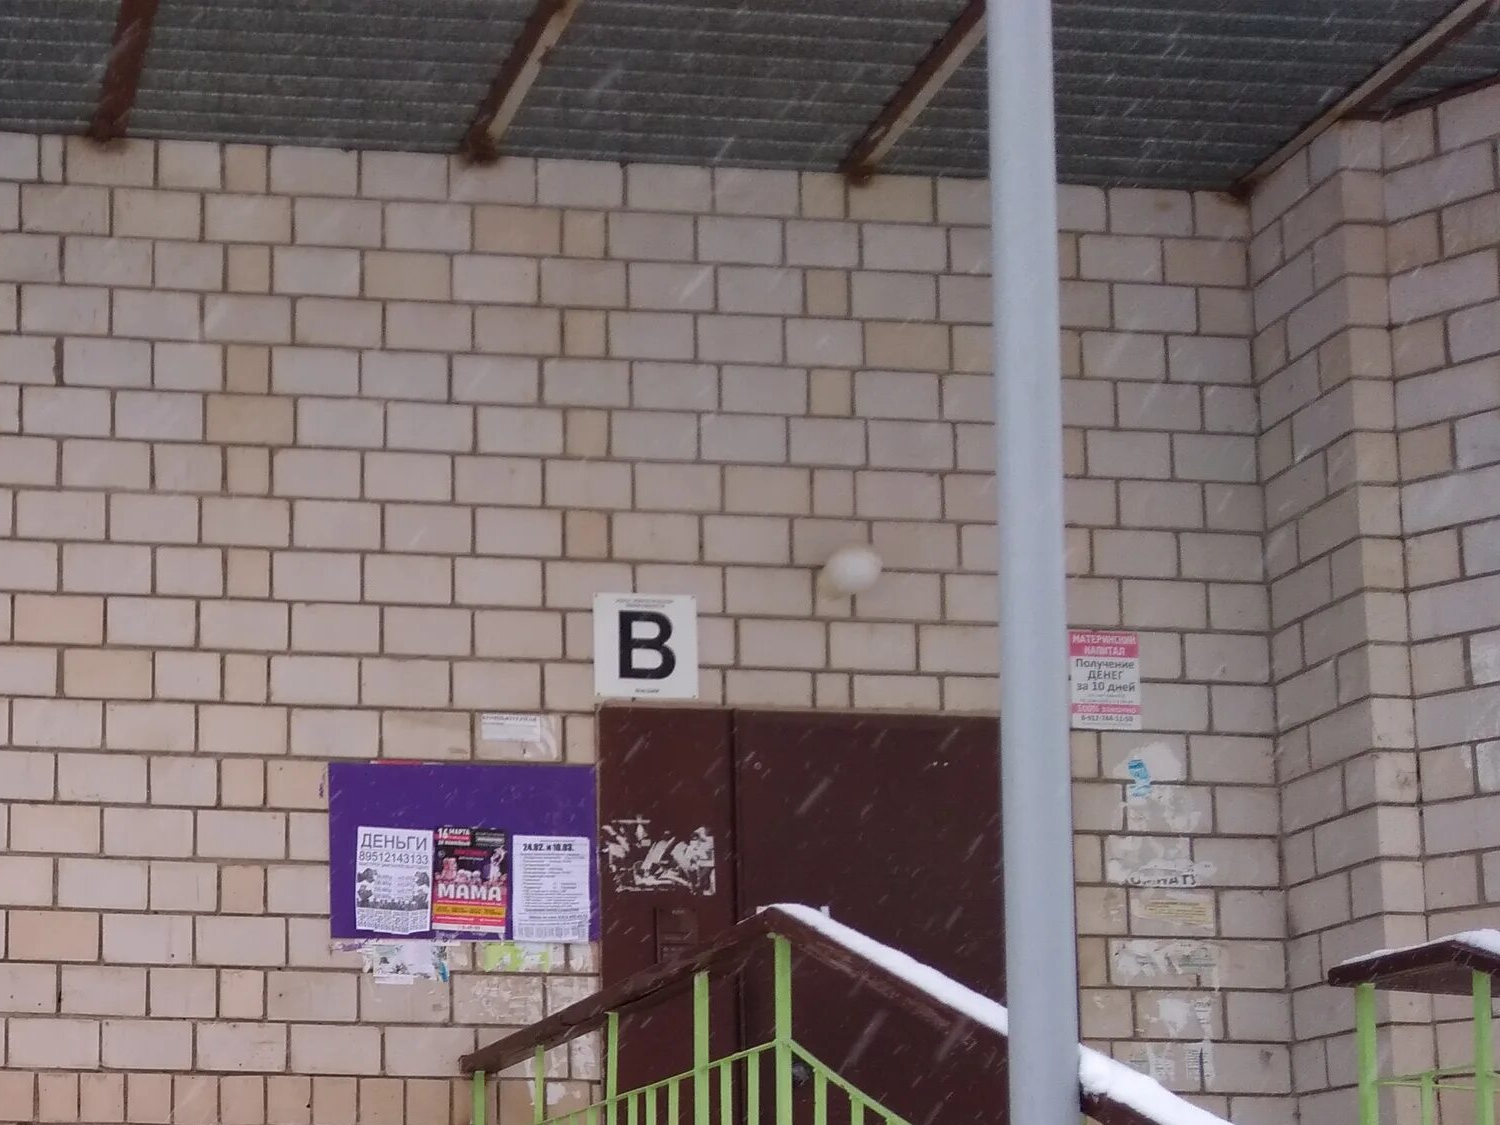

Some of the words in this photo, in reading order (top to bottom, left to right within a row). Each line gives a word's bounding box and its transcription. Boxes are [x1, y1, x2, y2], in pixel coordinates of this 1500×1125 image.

[1076, 658, 1135, 669] Получение
[1088, 670, 1124, 680] ДЕНЕГ
[1077, 683, 1088, 691] за
[1092, 682, 1105, 691] 10
[1107, 682, 1136, 692] дней
[437, 828, 449, 839] 16
[449, 828, 470, 836] МАРТА
[360, 833, 427, 851] ДЕНЬГИ
[358, 850, 429, 865] 89512143133
[437, 883, 502, 901] МАМА
